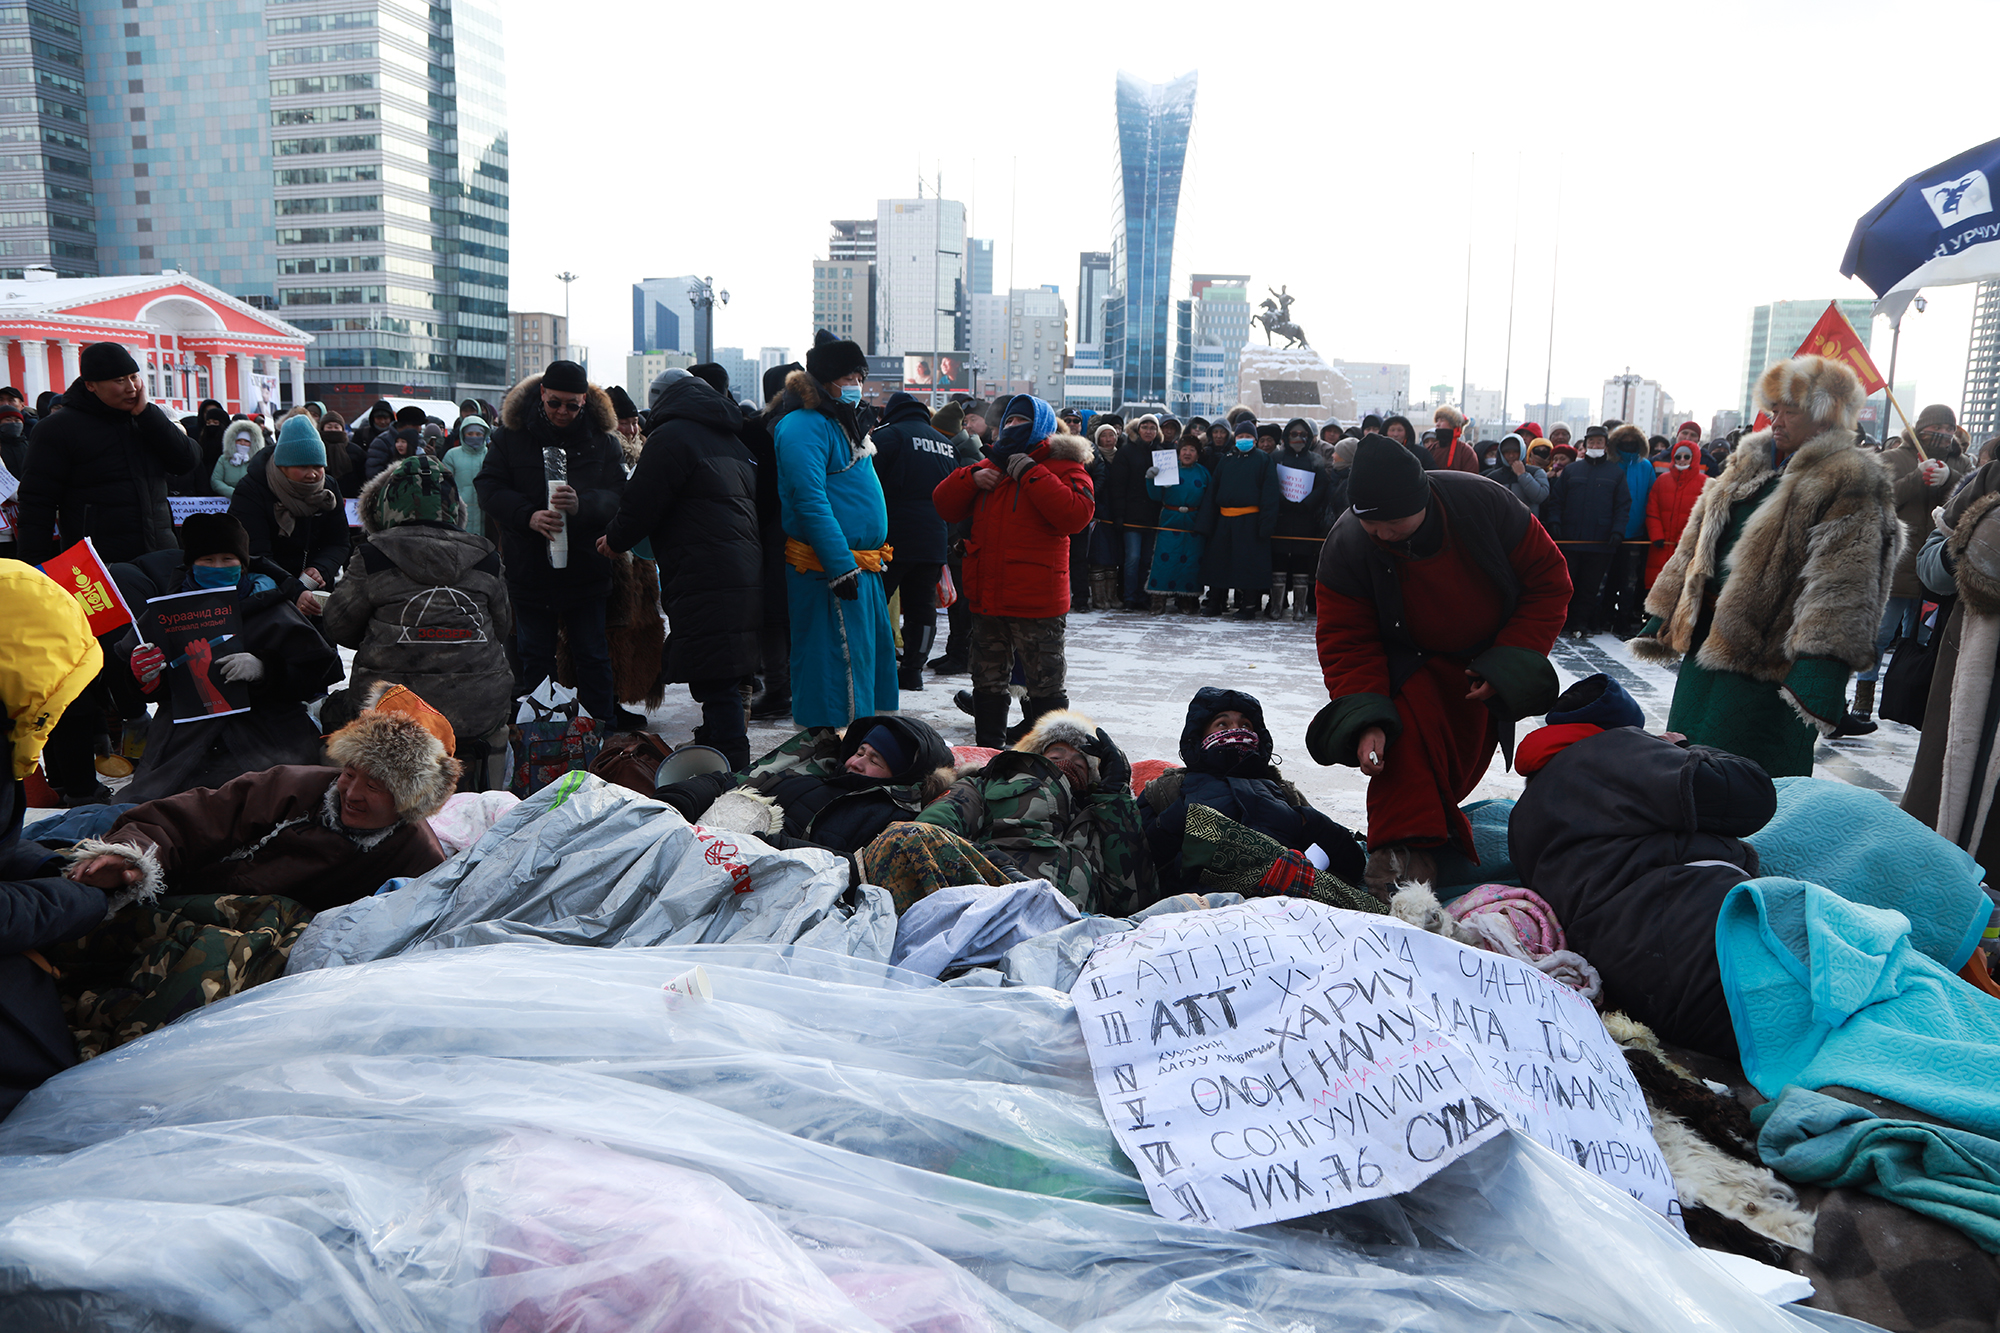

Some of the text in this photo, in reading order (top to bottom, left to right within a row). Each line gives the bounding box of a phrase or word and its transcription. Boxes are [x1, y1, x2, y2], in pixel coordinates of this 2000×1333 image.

[912, 437, 954, 459] POLICE
[158, 605, 232, 625] Зураачид аа!
